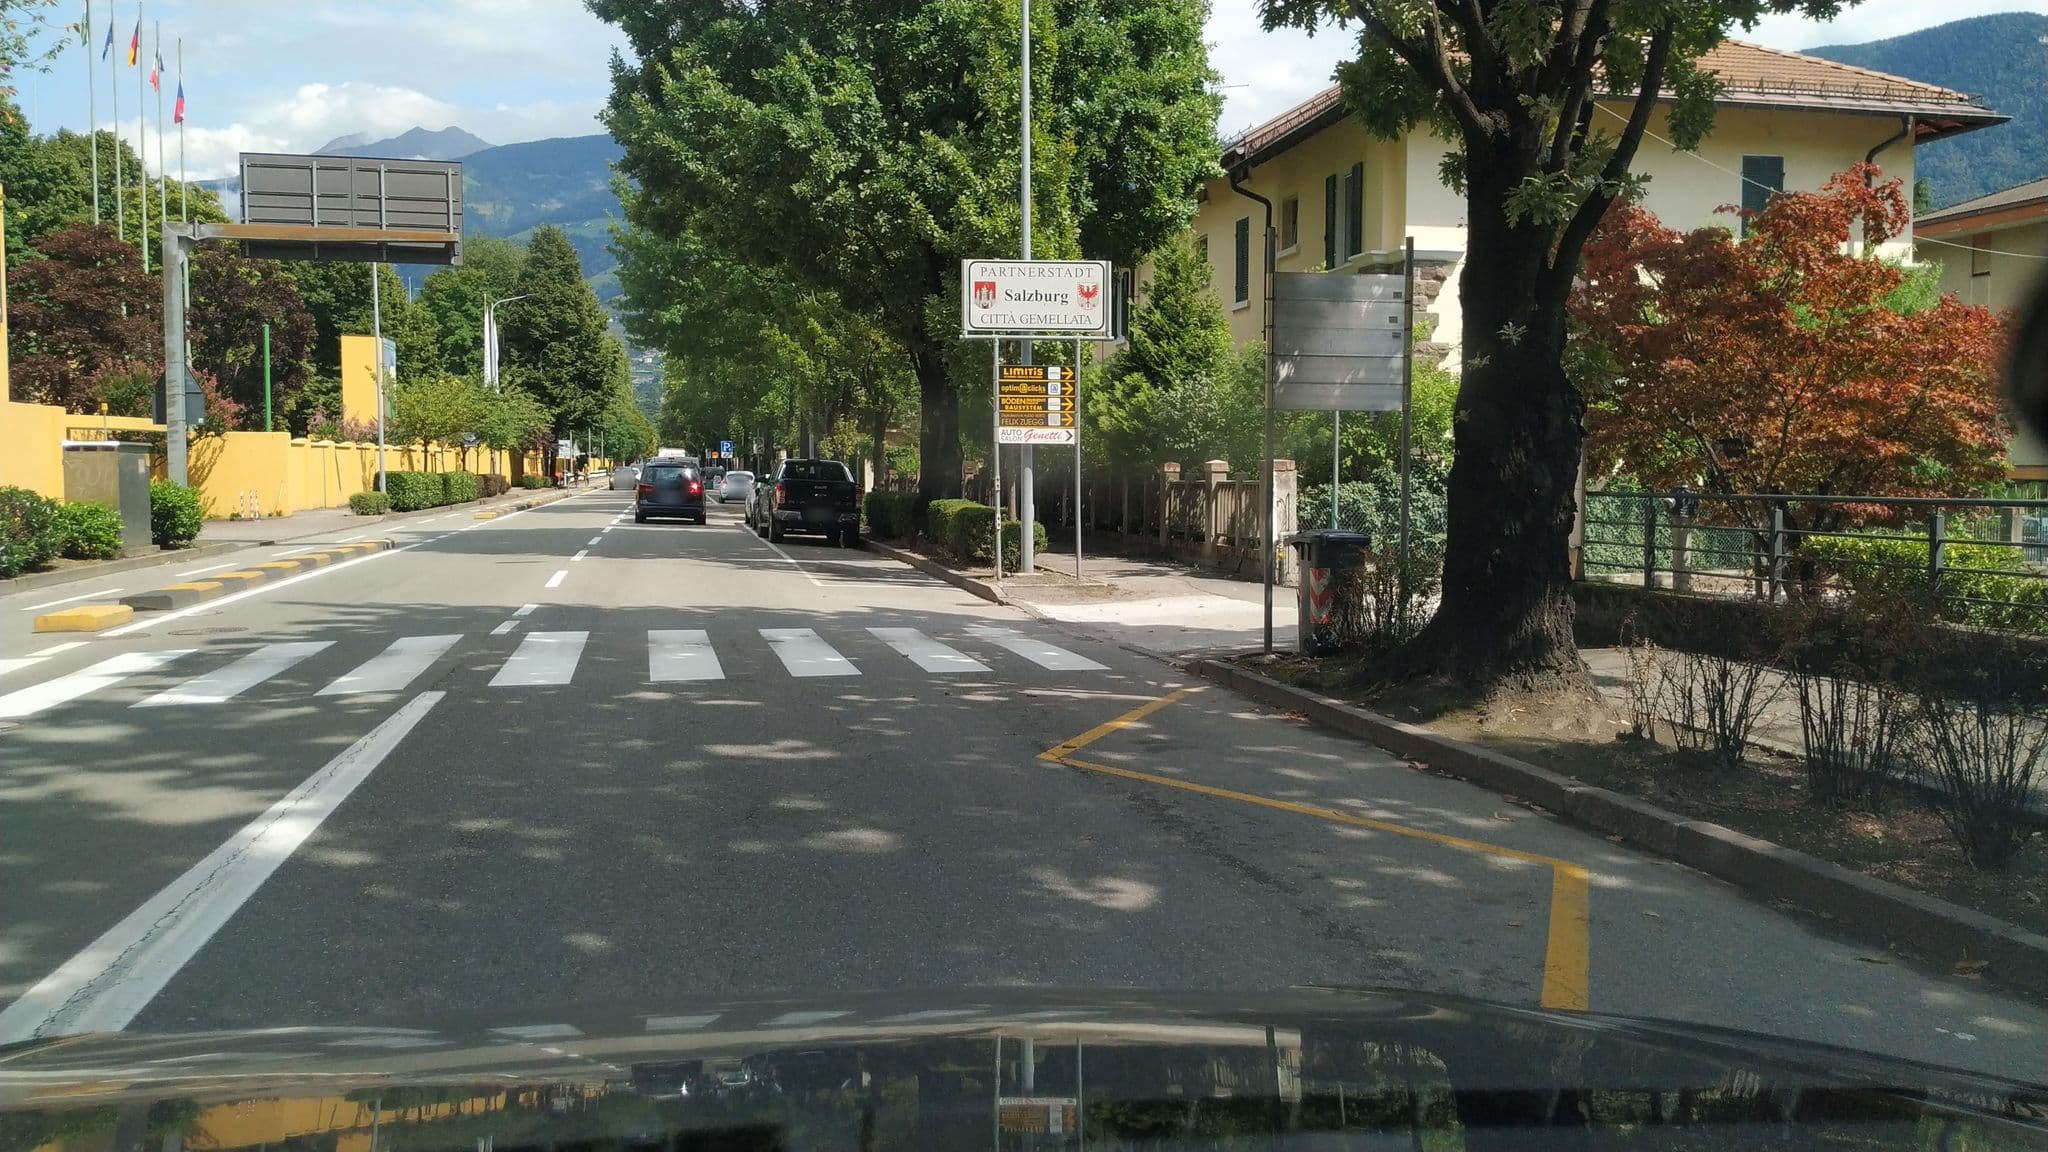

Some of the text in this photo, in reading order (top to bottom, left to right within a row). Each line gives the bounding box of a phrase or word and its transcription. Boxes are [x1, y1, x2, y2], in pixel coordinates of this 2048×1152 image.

[980, 266, 1094, 278] PARTNERSTADT
[1004, 288, 1069, 305] Salzburg
[980, 311, 1093, 325] CITTÀ GEMELLATA
